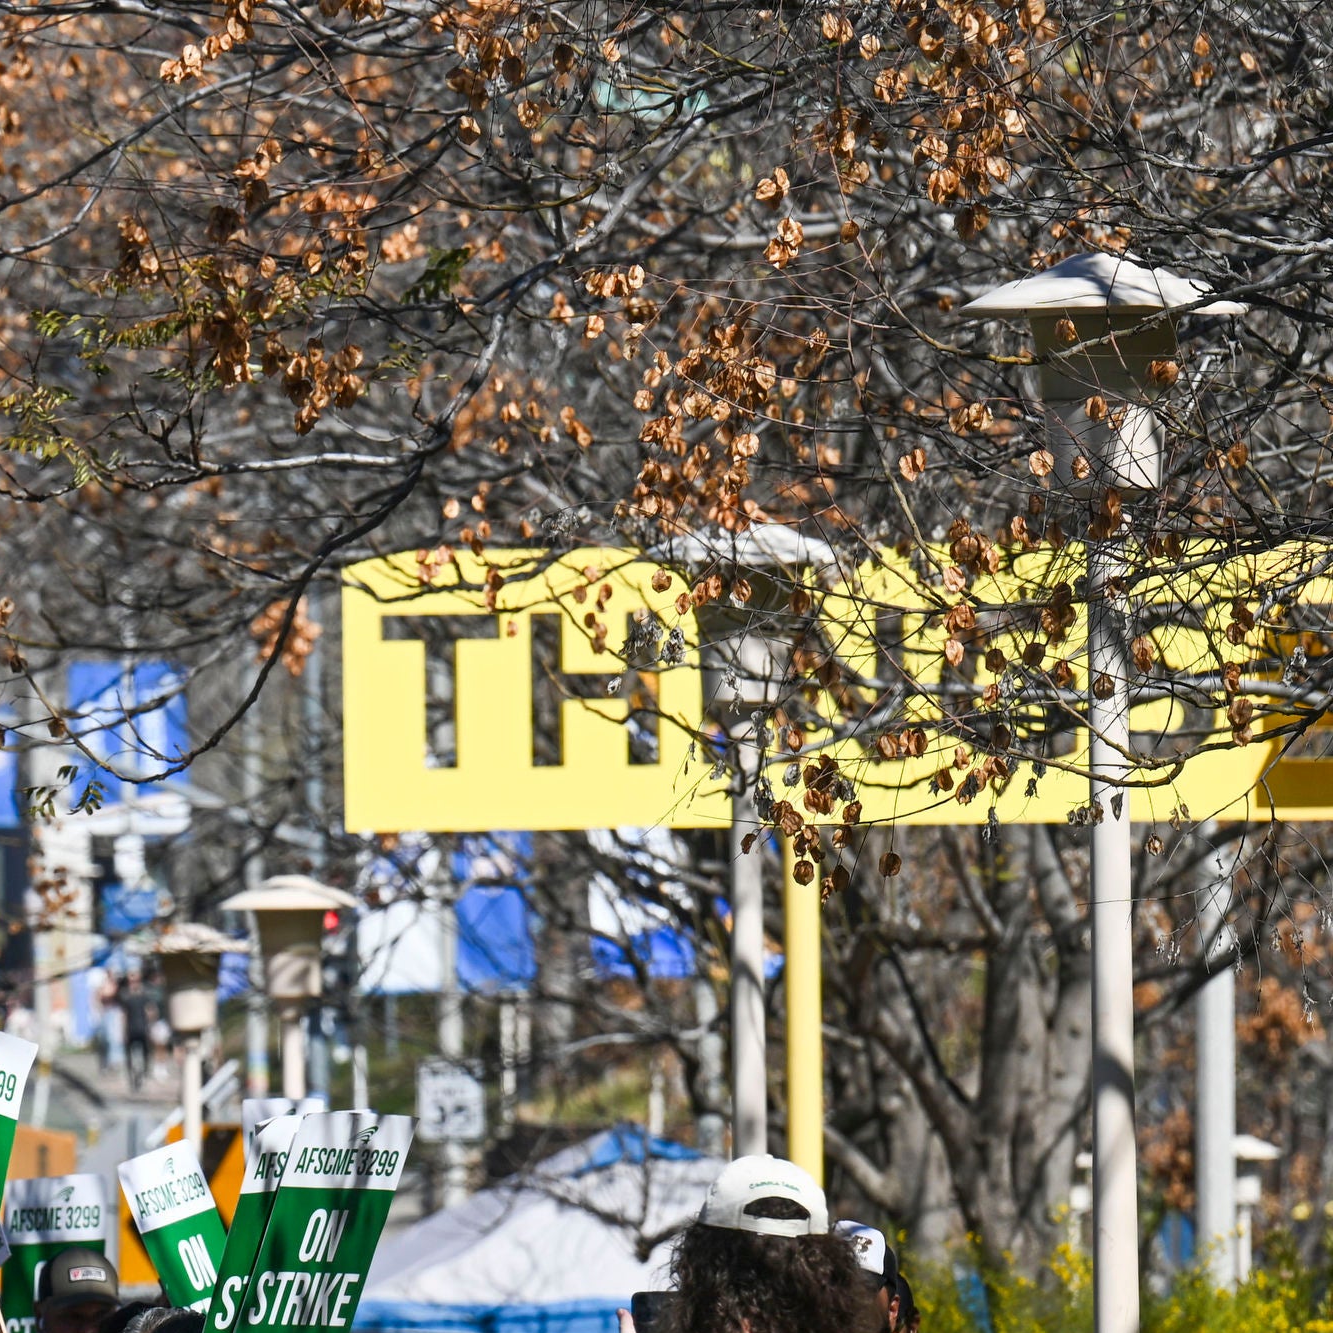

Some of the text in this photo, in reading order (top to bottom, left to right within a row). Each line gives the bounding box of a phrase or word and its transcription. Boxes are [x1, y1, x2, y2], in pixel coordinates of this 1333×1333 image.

[254, 1151, 289, 1180] AFS
[294, 1147, 400, 1178] AFSCME 3299
[10, 1205, 101, 1234] AFSCME 3299
[135, 1172, 206, 1220] AFSCME 3299
[299, 1208, 350, 1263] ON
[177, 1233, 218, 1292] ON
[247, 1271, 361, 1328] STRIKE
